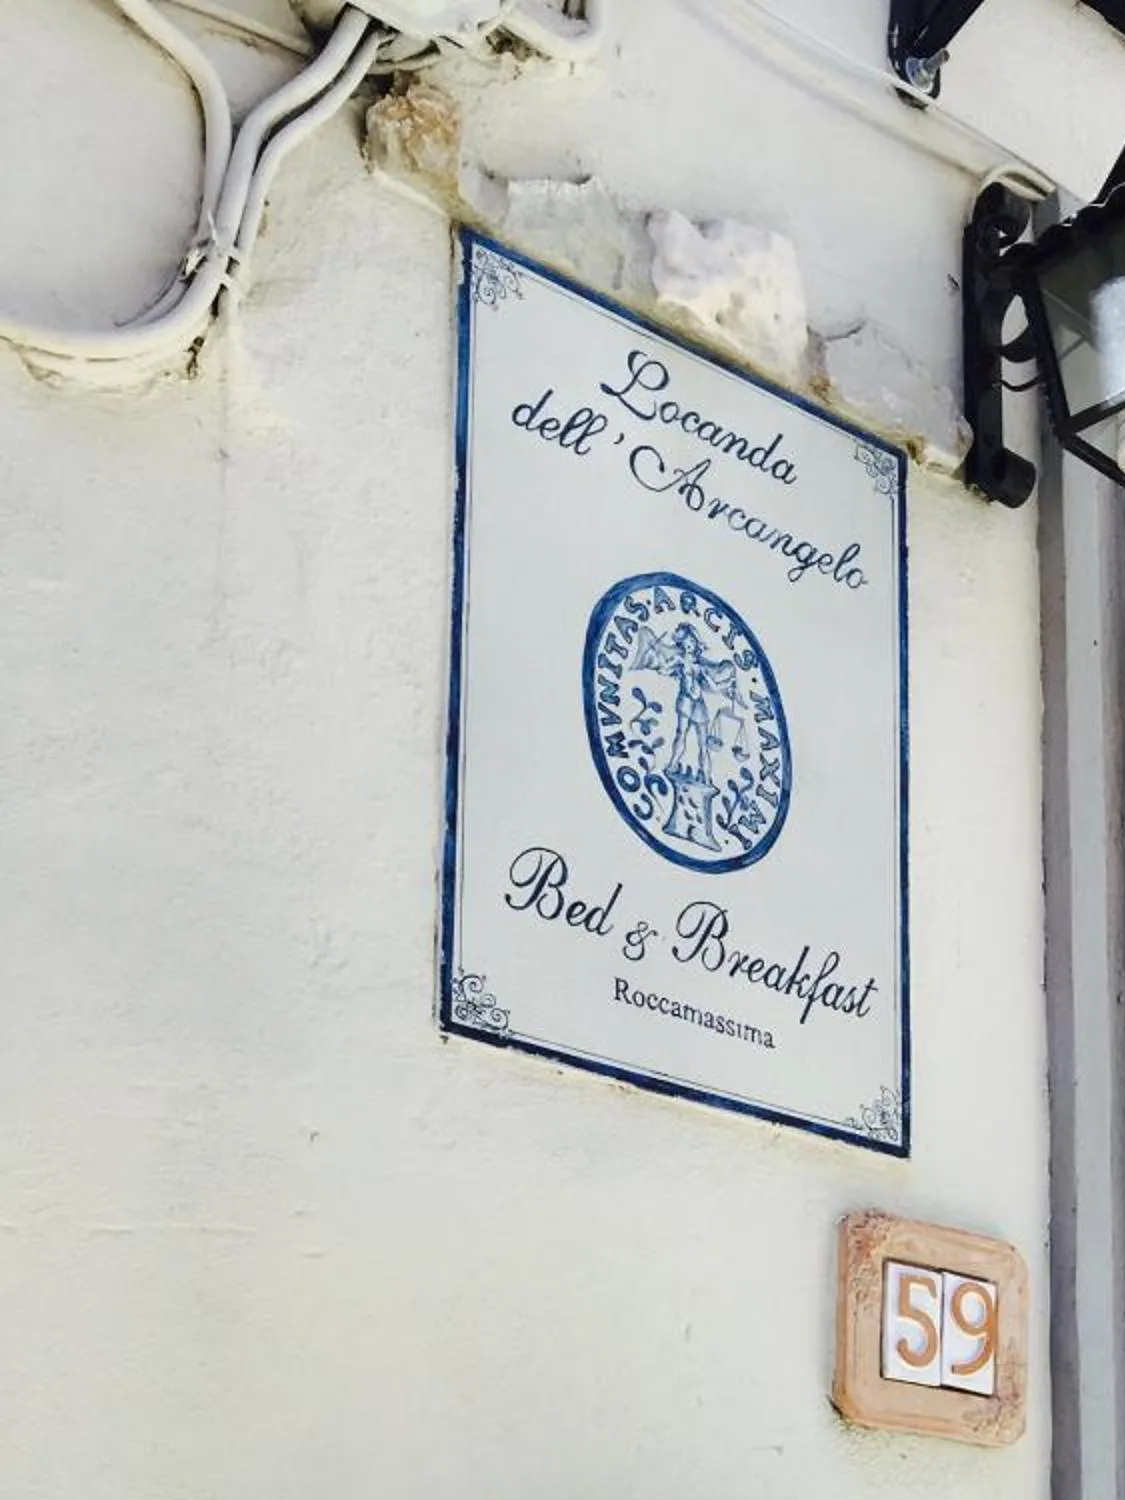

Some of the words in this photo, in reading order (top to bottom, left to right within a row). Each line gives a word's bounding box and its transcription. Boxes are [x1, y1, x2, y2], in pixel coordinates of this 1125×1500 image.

[600, 350, 797, 485] Locanda
[511, 390, 625, 456] dell'
[629, 445, 869, 589] Arcangelo
[504, 847, 622, 936] Bed
[622, 921, 659, 961] &
[671, 901, 878, 1024] Breakfast
[614, 976, 777, 1050] Roccamassima
[896, 1273, 995, 1375] 59
